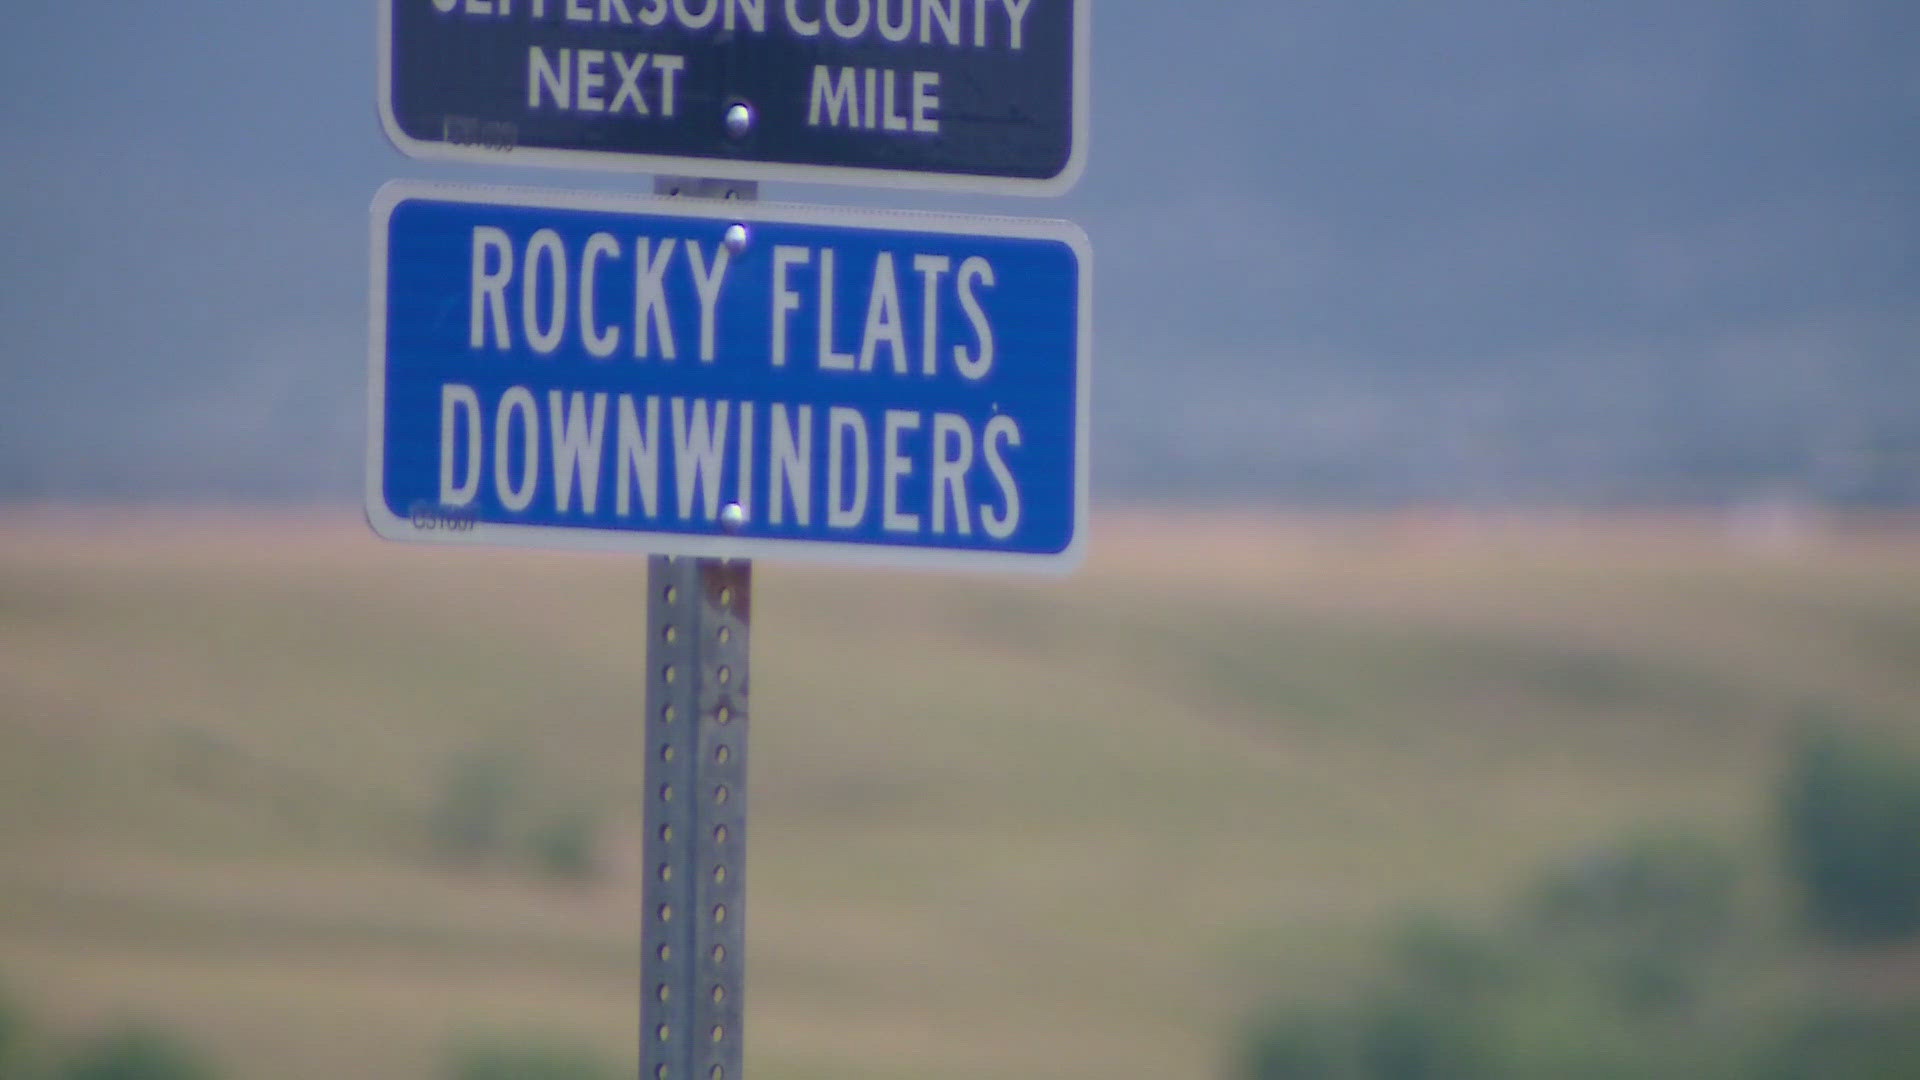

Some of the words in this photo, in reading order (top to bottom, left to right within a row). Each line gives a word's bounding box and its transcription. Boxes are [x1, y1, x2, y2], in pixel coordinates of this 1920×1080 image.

[784, 0, 1031, 50] COUNTY
[529, 48, 683, 116] NEXT
[809, 66, 940, 132] MILE
[471, 226, 729, 362] ROCKY
[772, 244, 997, 380] FLATS
[440, 384, 1022, 538] DOWNWINDERS
